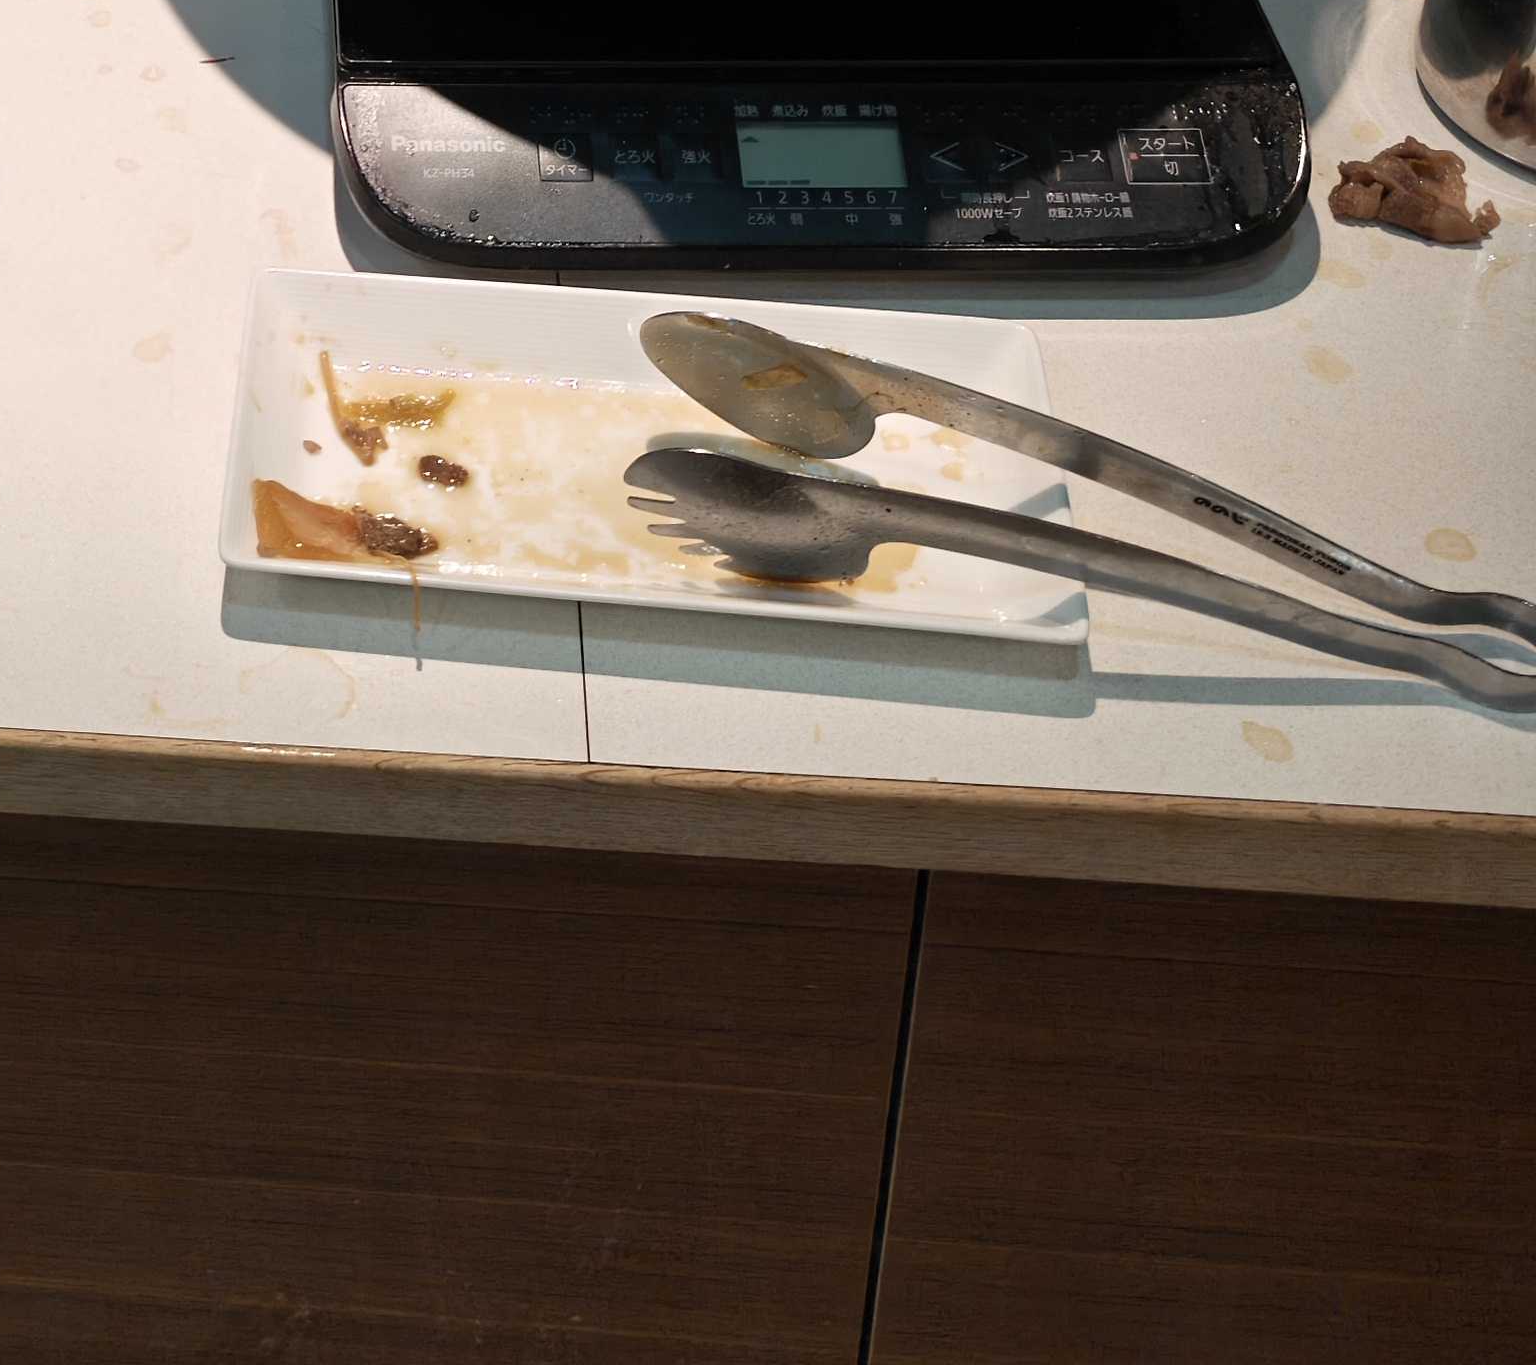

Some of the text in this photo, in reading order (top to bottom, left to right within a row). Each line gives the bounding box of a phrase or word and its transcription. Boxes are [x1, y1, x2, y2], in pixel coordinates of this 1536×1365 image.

[770, 103, 809, 118] 煮込み
[391, 135, 506, 154] Panasonic
[1137, 136, 1196, 151] スタート
[614, 149, 657, 165] とろ火
[680, 149, 712, 165] 強火
[1060, 150, 1105, 164] コース
[544, 163, 589, 177] タイマー
[1163, 160, 1180, 177] 切
[643, 191, 696, 204] ワンタッチ
[755, 190, 898, 204] 1 2 3 4 5 6 7
[747, 212, 777, 227] とろ火
[845, 212, 859, 227] 中
